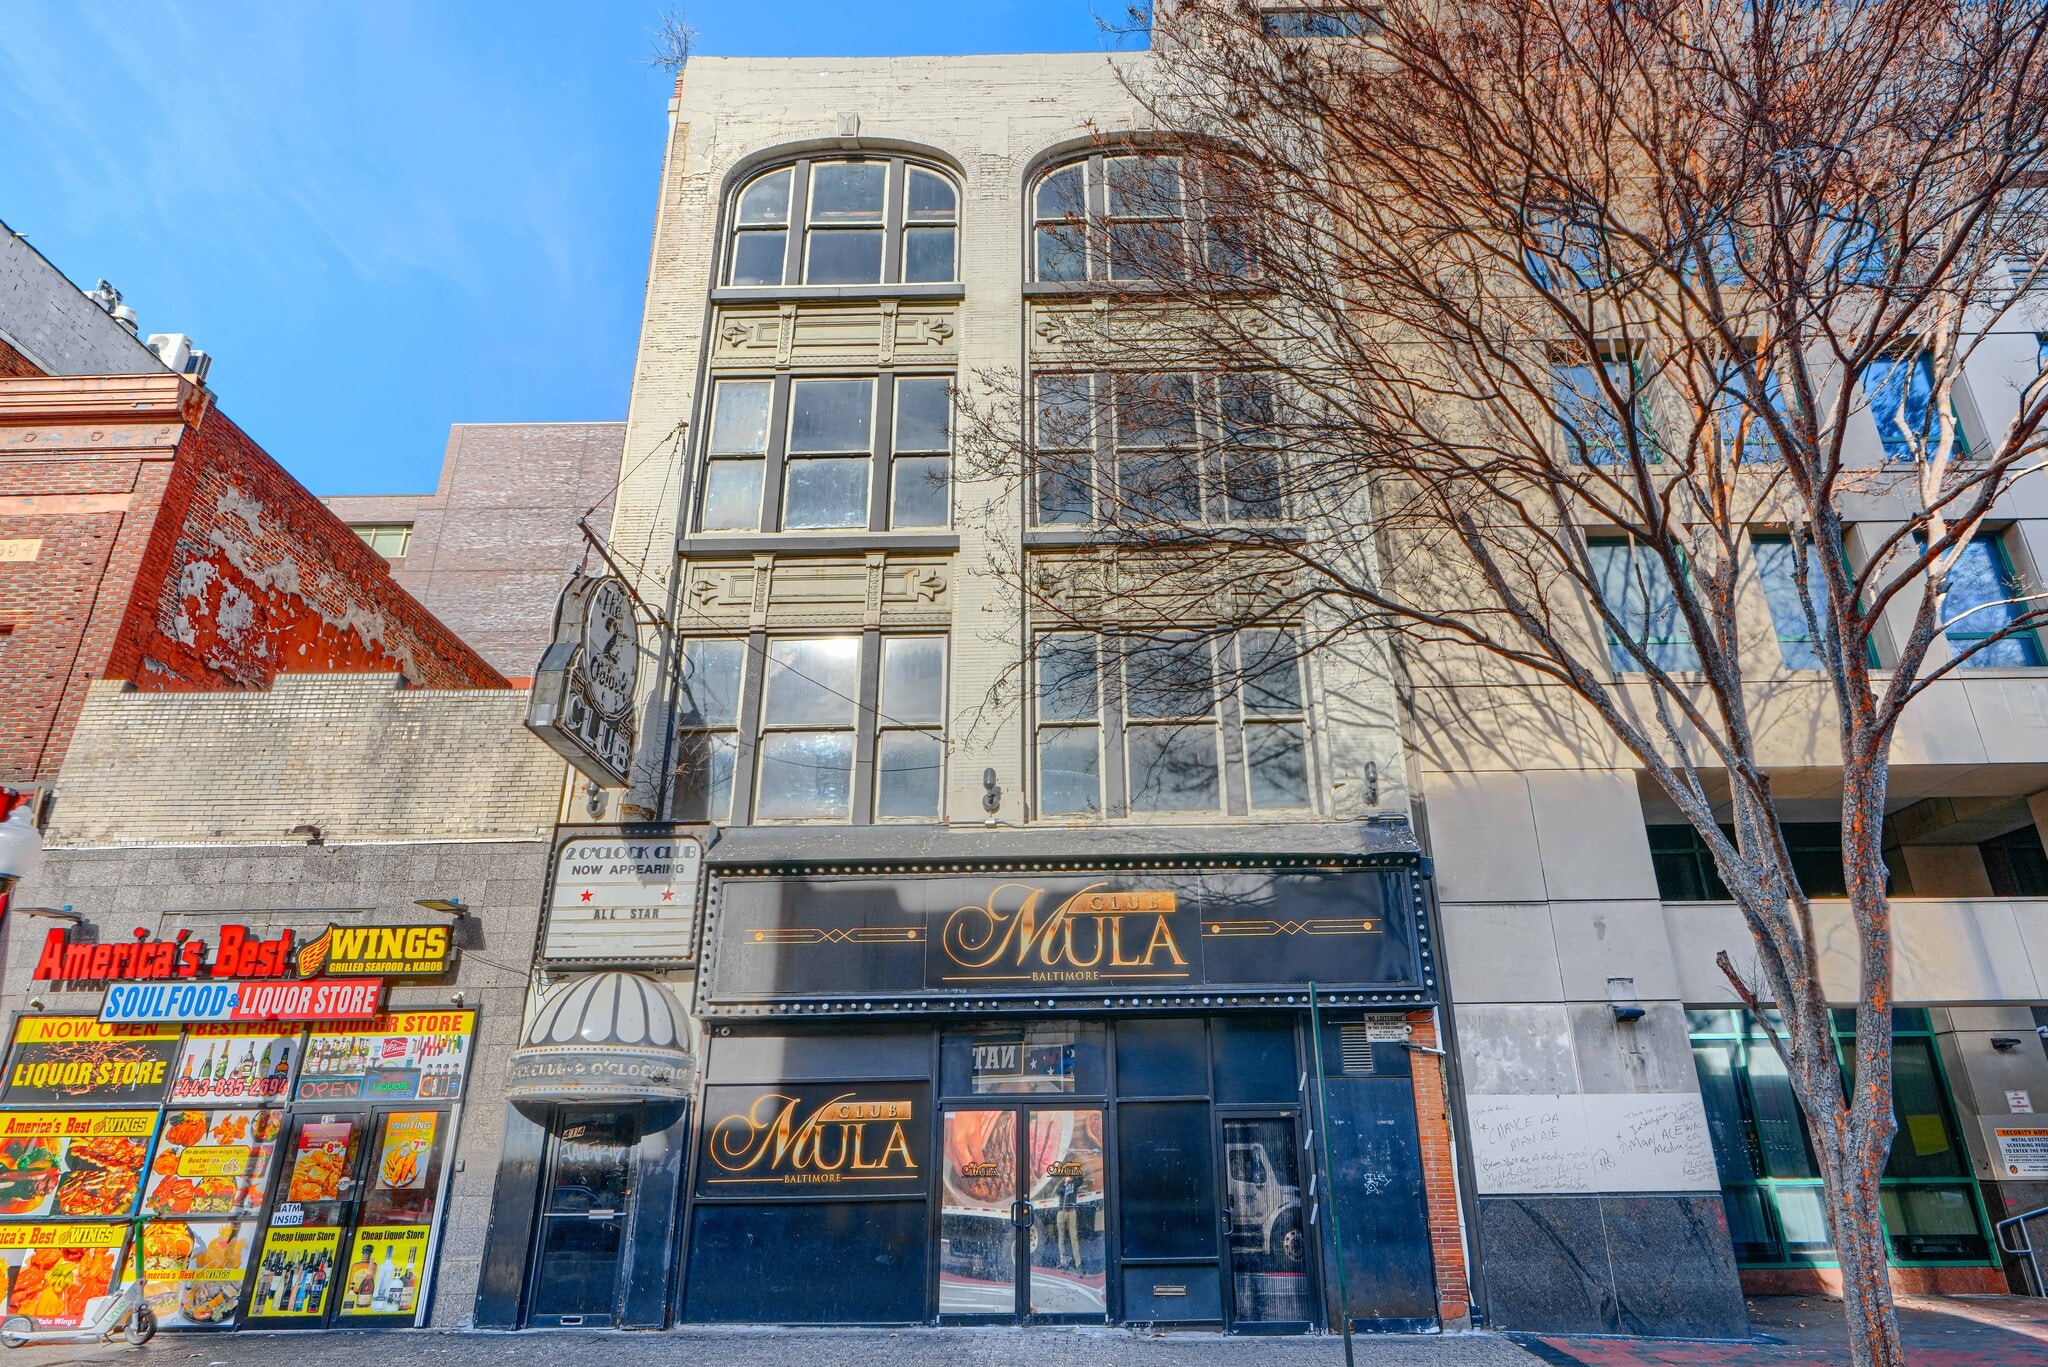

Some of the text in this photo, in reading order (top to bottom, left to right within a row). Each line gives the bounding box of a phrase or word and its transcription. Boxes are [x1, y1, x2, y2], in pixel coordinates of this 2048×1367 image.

[565, 695, 631, 773] CLUB
[564, 845, 697, 861] 2 O'CLOCK CLUB
[571, 863, 685, 876] NOW APPEARING
[1090, 895, 1159, 911] CLUB
[593, 908, 659, 920] ALL STAR
[943, 882, 1189, 967] MULA
[33, 924, 447, 980] America's Best WINGS
[329, 961, 443, 973] GRILLED SEAFOOD & KABOB
[1031, 971, 1100, 982] BALTIMORE
[105, 985, 377, 1018] SOULFOOD & LIQUOR STORE
[40, 1022, 159, 1038] NOW OPEN
[195, 1021, 301, 1036] BEST PRICE
[403, 1015, 463, 1033] STORE
[12, 1061, 168, 1089] LIQUOR STORE
[180, 1077, 288, 1097] 443-835-2694
[300, 1081, 359, 1099] OPEN
[372, 1083, 408, 1091] LIQUOR
[838, 1104, 898, 1119] CLUB
[4, 1117, 148, 1134] America's Best WINGS
[391, 1121, 431, 1129] WHITING
[710, 1092, 919, 1171] MULA
[784, 1174, 841, 1184] BALTIMORE
[281, 1204, 300, 1213] ATM
[274, 1215, 303, 1224] INSIDE
[29, 1227, 57, 1245] Best
[68, 1227, 115, 1244] WINGS
[272, 1231, 336, 1242] Cheap Liquor Store
[361, 1230, 425, 1241] Cheap Liquor Store
[179, 1270, 195, 1279] Best
[204, 1270, 231, 1279] WINGS
[104, 1300, 127, 1323] Lime
[54, 1317, 77, 1326] Wings
